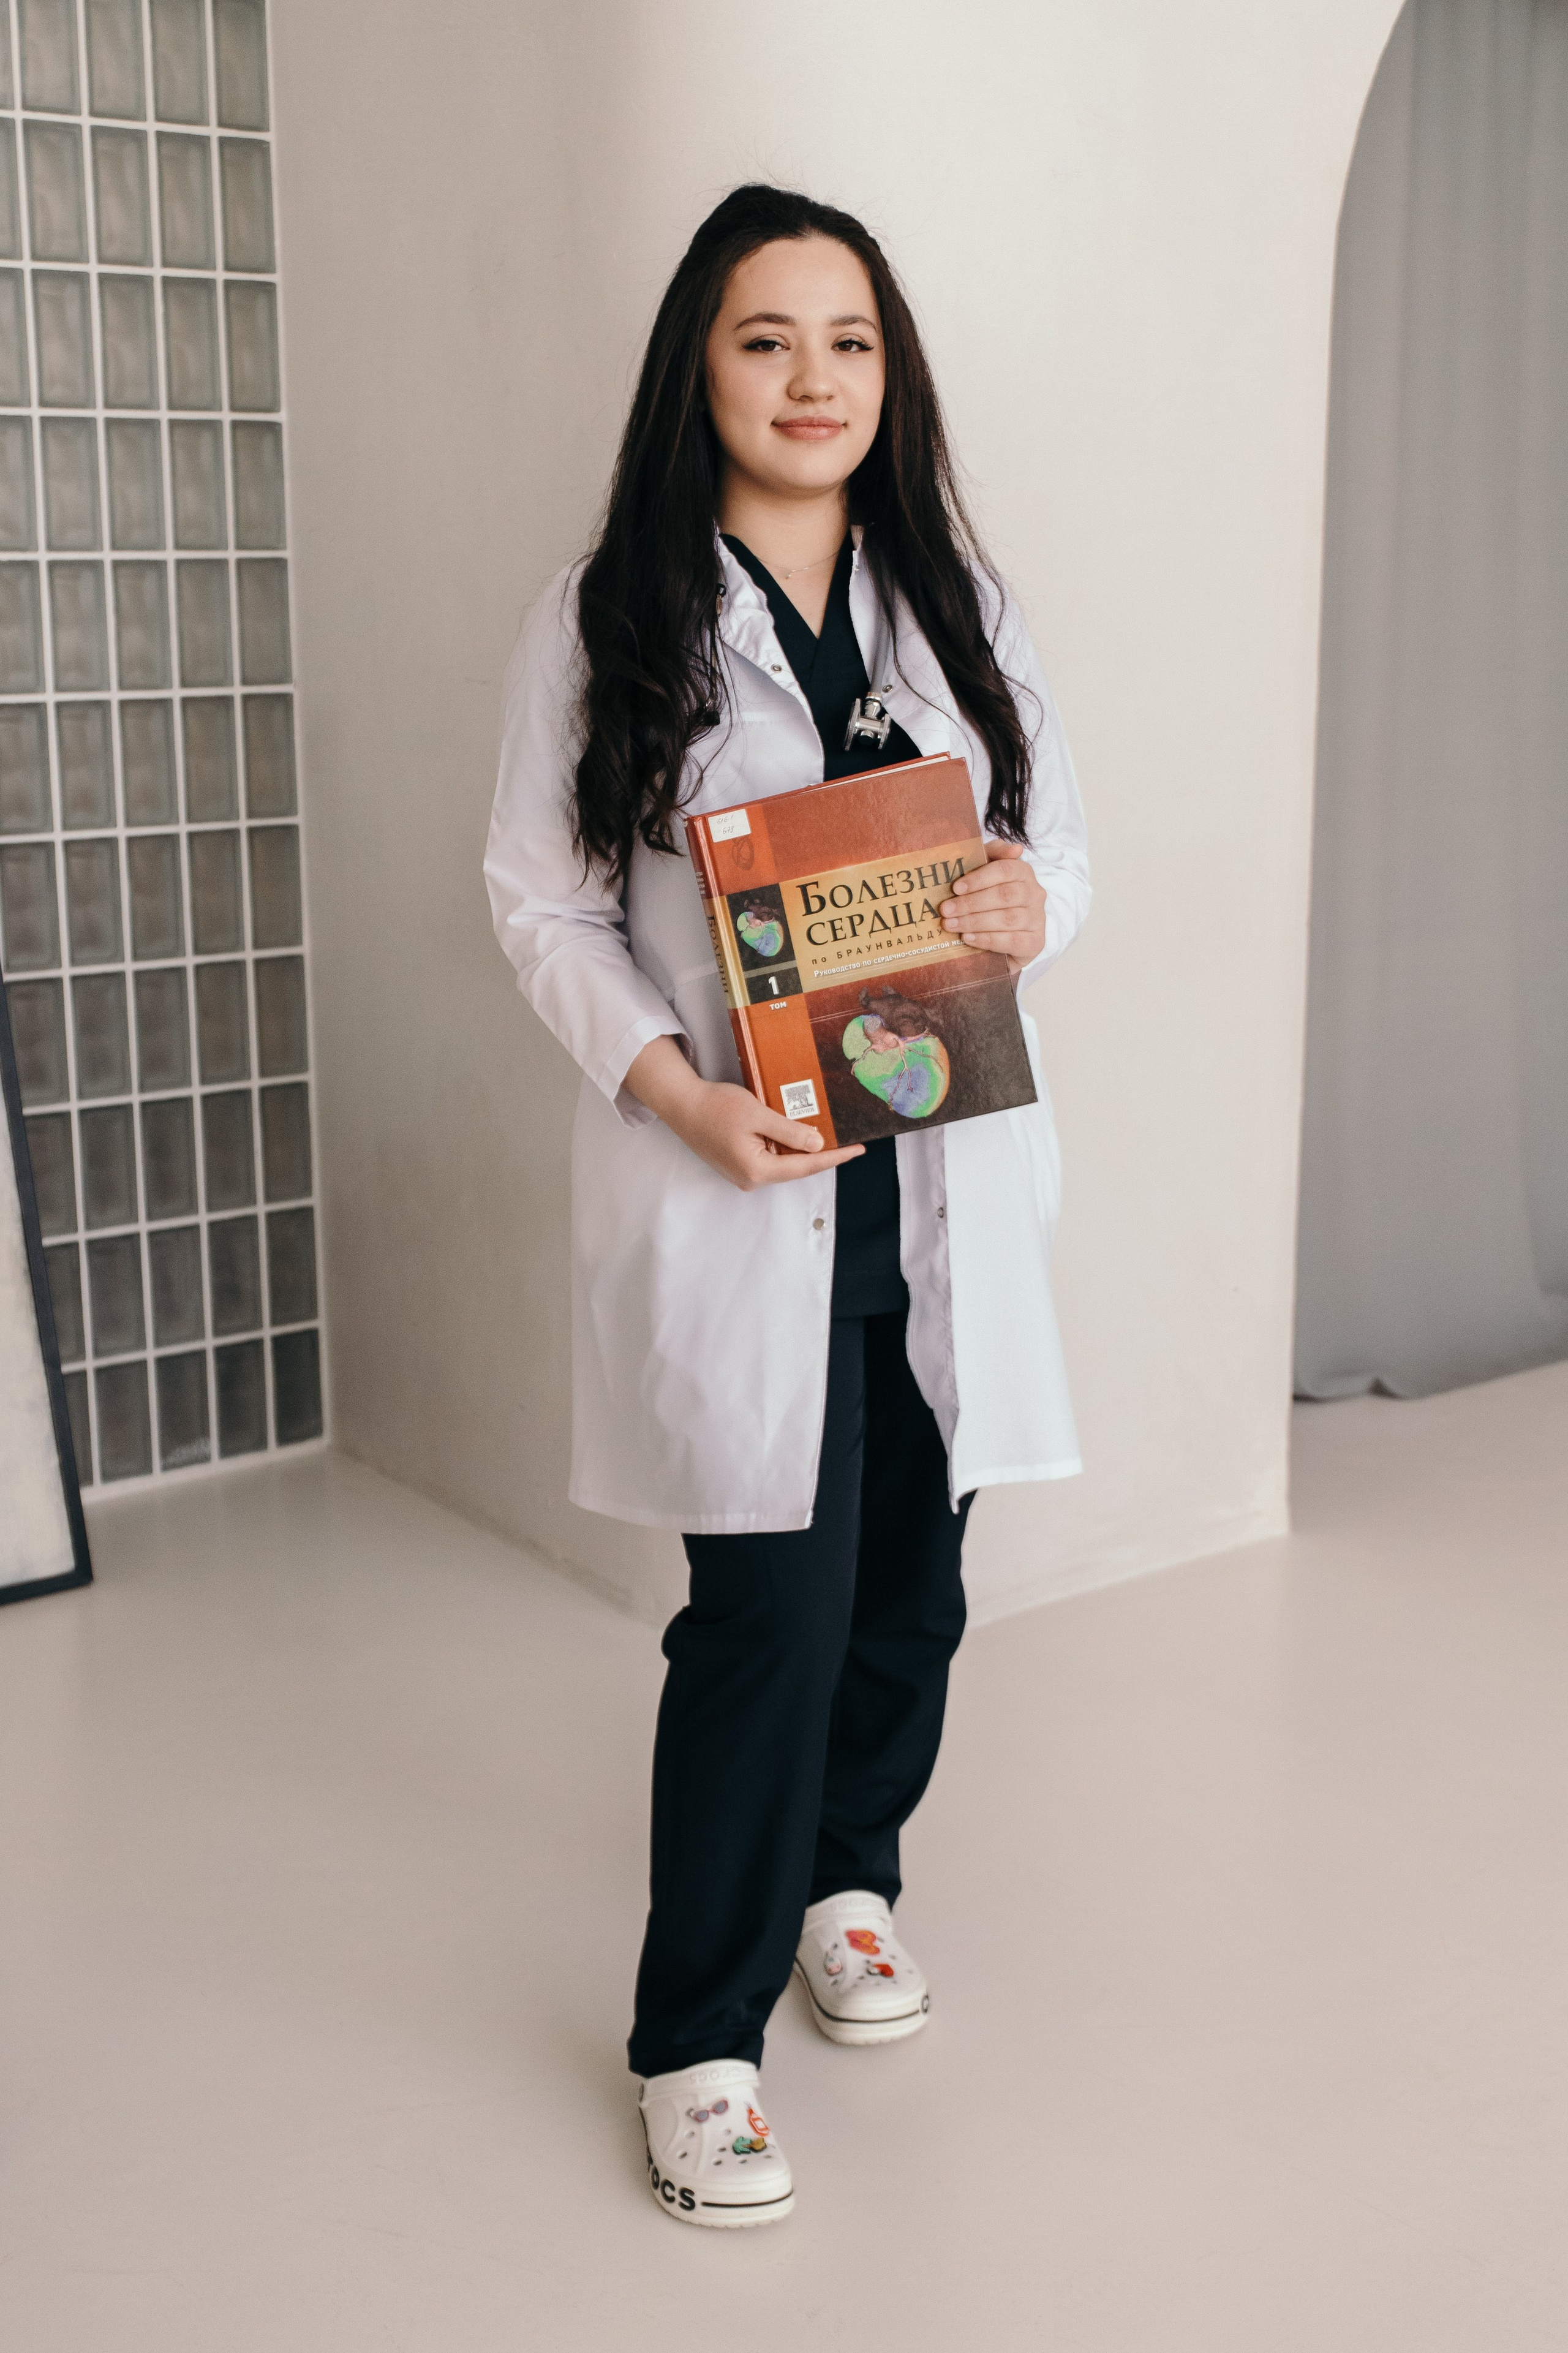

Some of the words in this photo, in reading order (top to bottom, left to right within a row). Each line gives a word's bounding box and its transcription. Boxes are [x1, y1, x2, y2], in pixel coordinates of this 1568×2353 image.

[796, 858, 965, 916] БОЛЕЗНИ
[805, 897, 941, 946] СЕРДЦА
[837, 927, 943, 959] БРАУНВАЛЬДУ
[767, 976, 780, 995] 1
[789, 1107, 815, 1117] ELSEVIER
